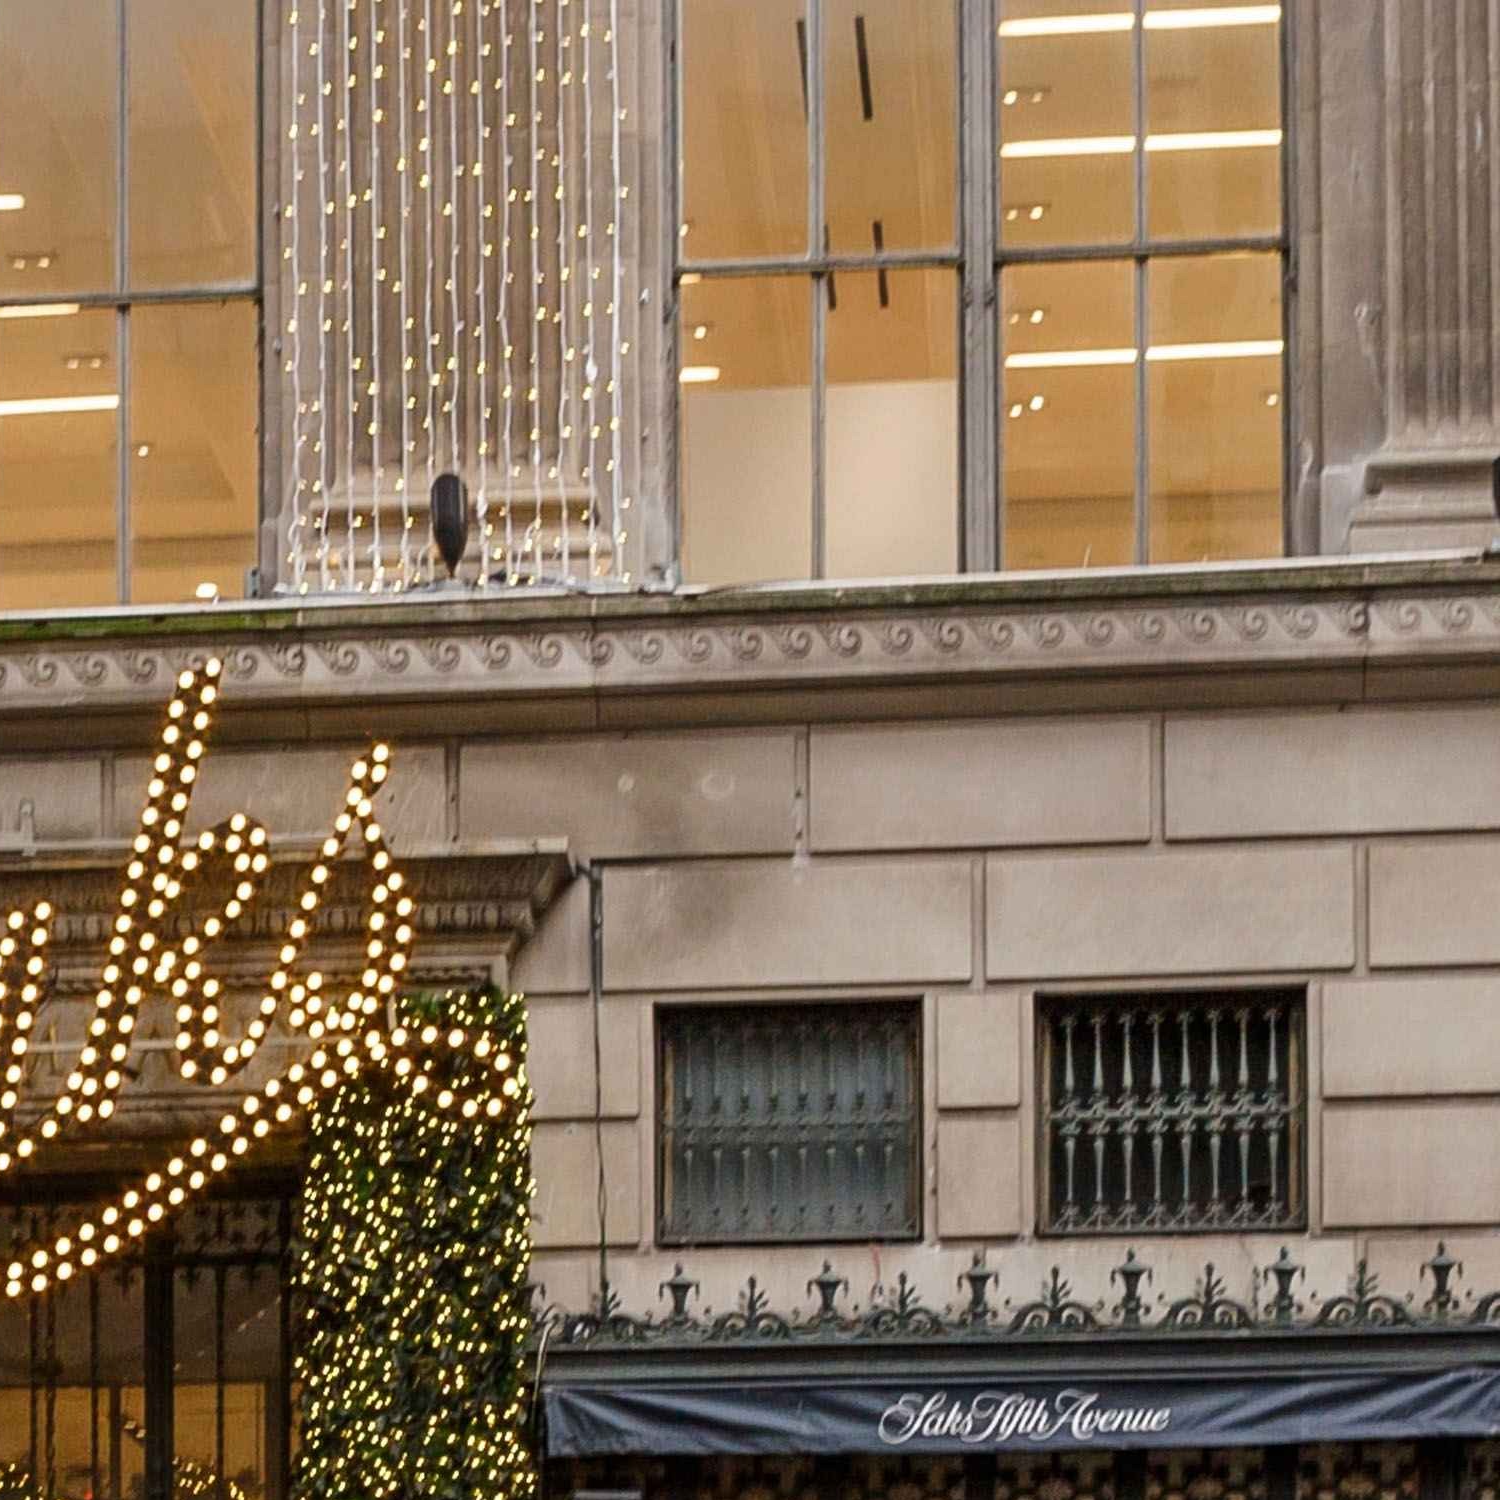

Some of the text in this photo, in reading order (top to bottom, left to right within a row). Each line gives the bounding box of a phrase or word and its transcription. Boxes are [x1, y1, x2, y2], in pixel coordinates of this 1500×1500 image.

[878, 1388, 1171, 1444] Saks Fifth Avenue
